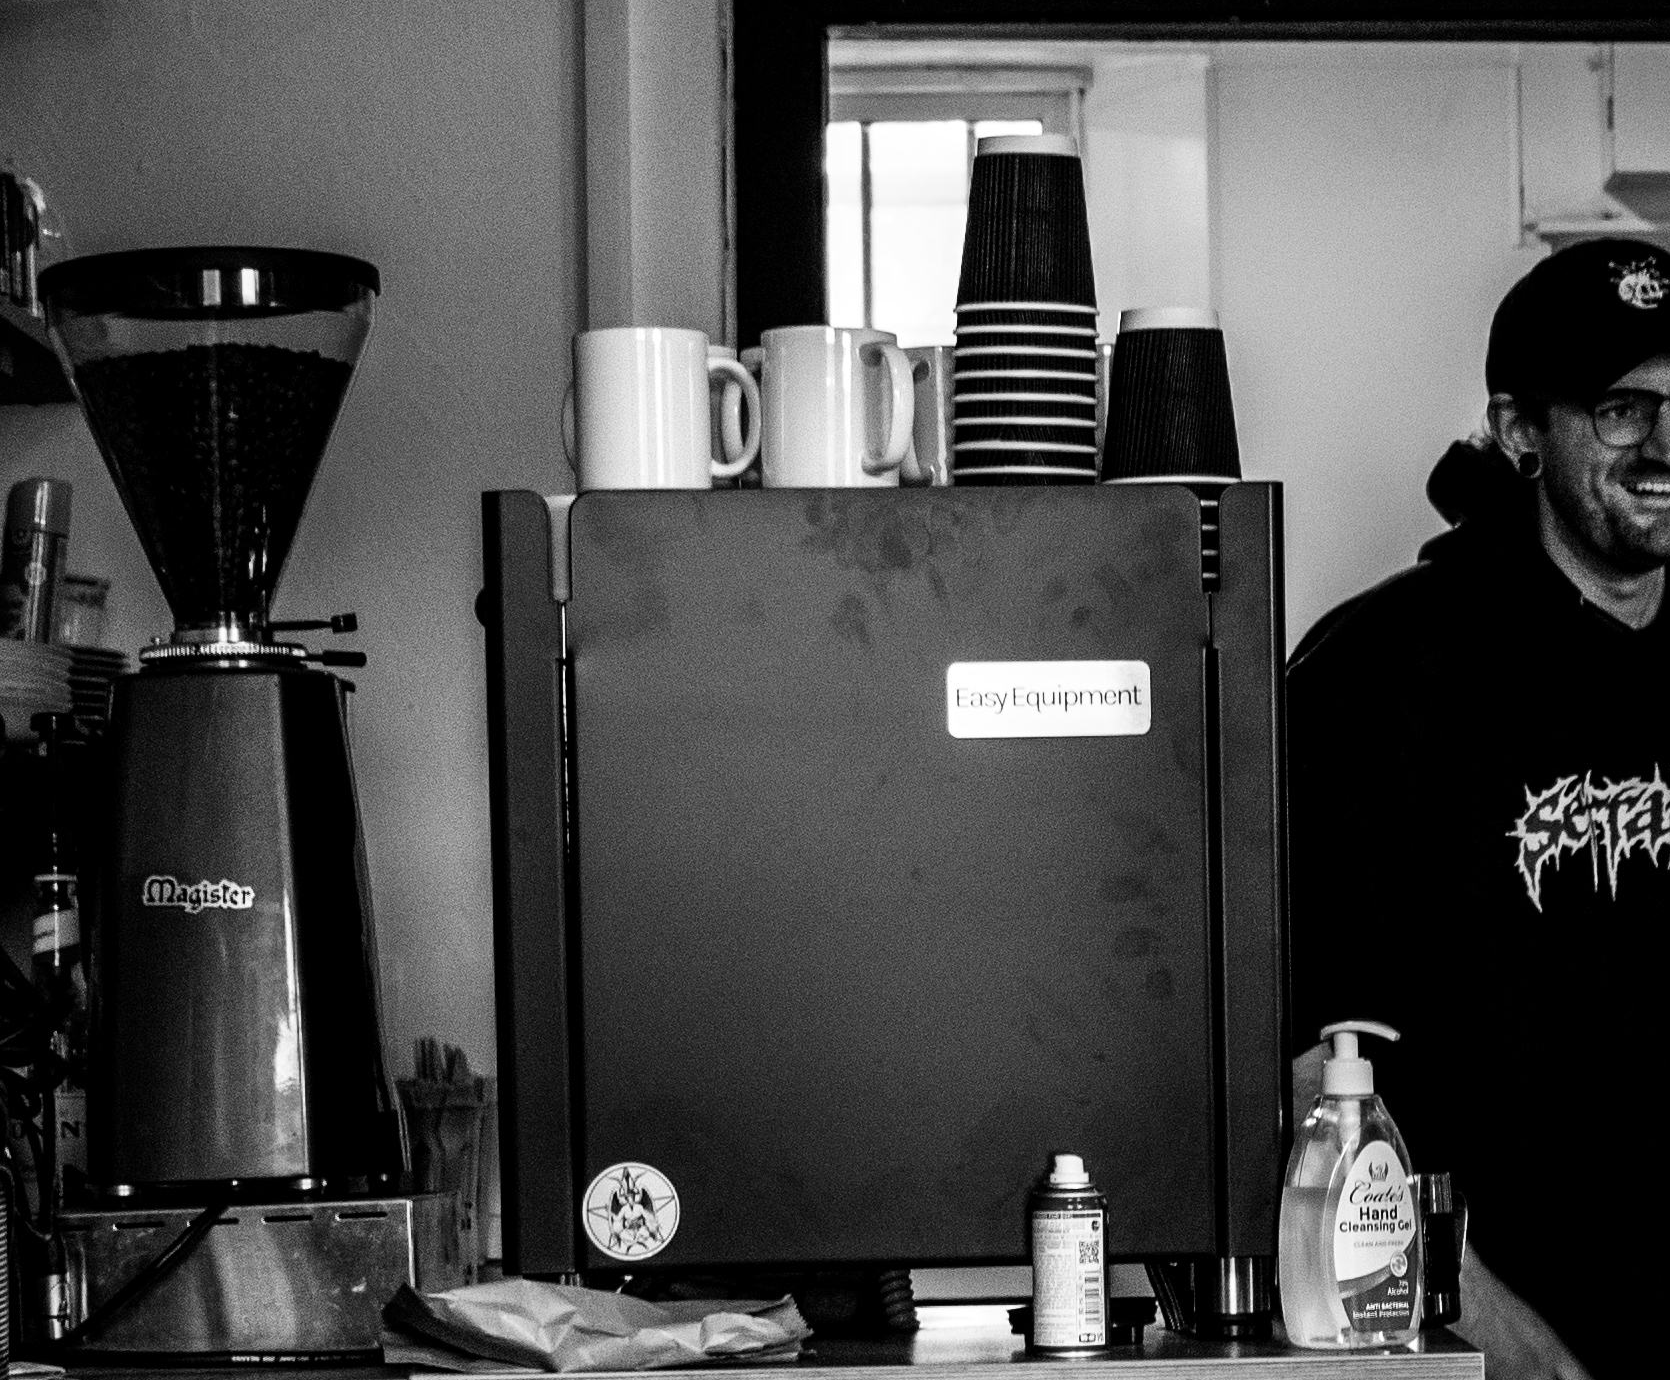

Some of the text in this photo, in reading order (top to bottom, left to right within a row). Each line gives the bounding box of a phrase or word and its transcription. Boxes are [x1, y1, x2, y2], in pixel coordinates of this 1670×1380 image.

[955, 684, 1143, 715] Easy Equipment
[145, 878, 253, 911] Magister
[1359, 1204, 1398, 1221] Hand
[1339, 1219, 1412, 1234] Cleansing Gel
